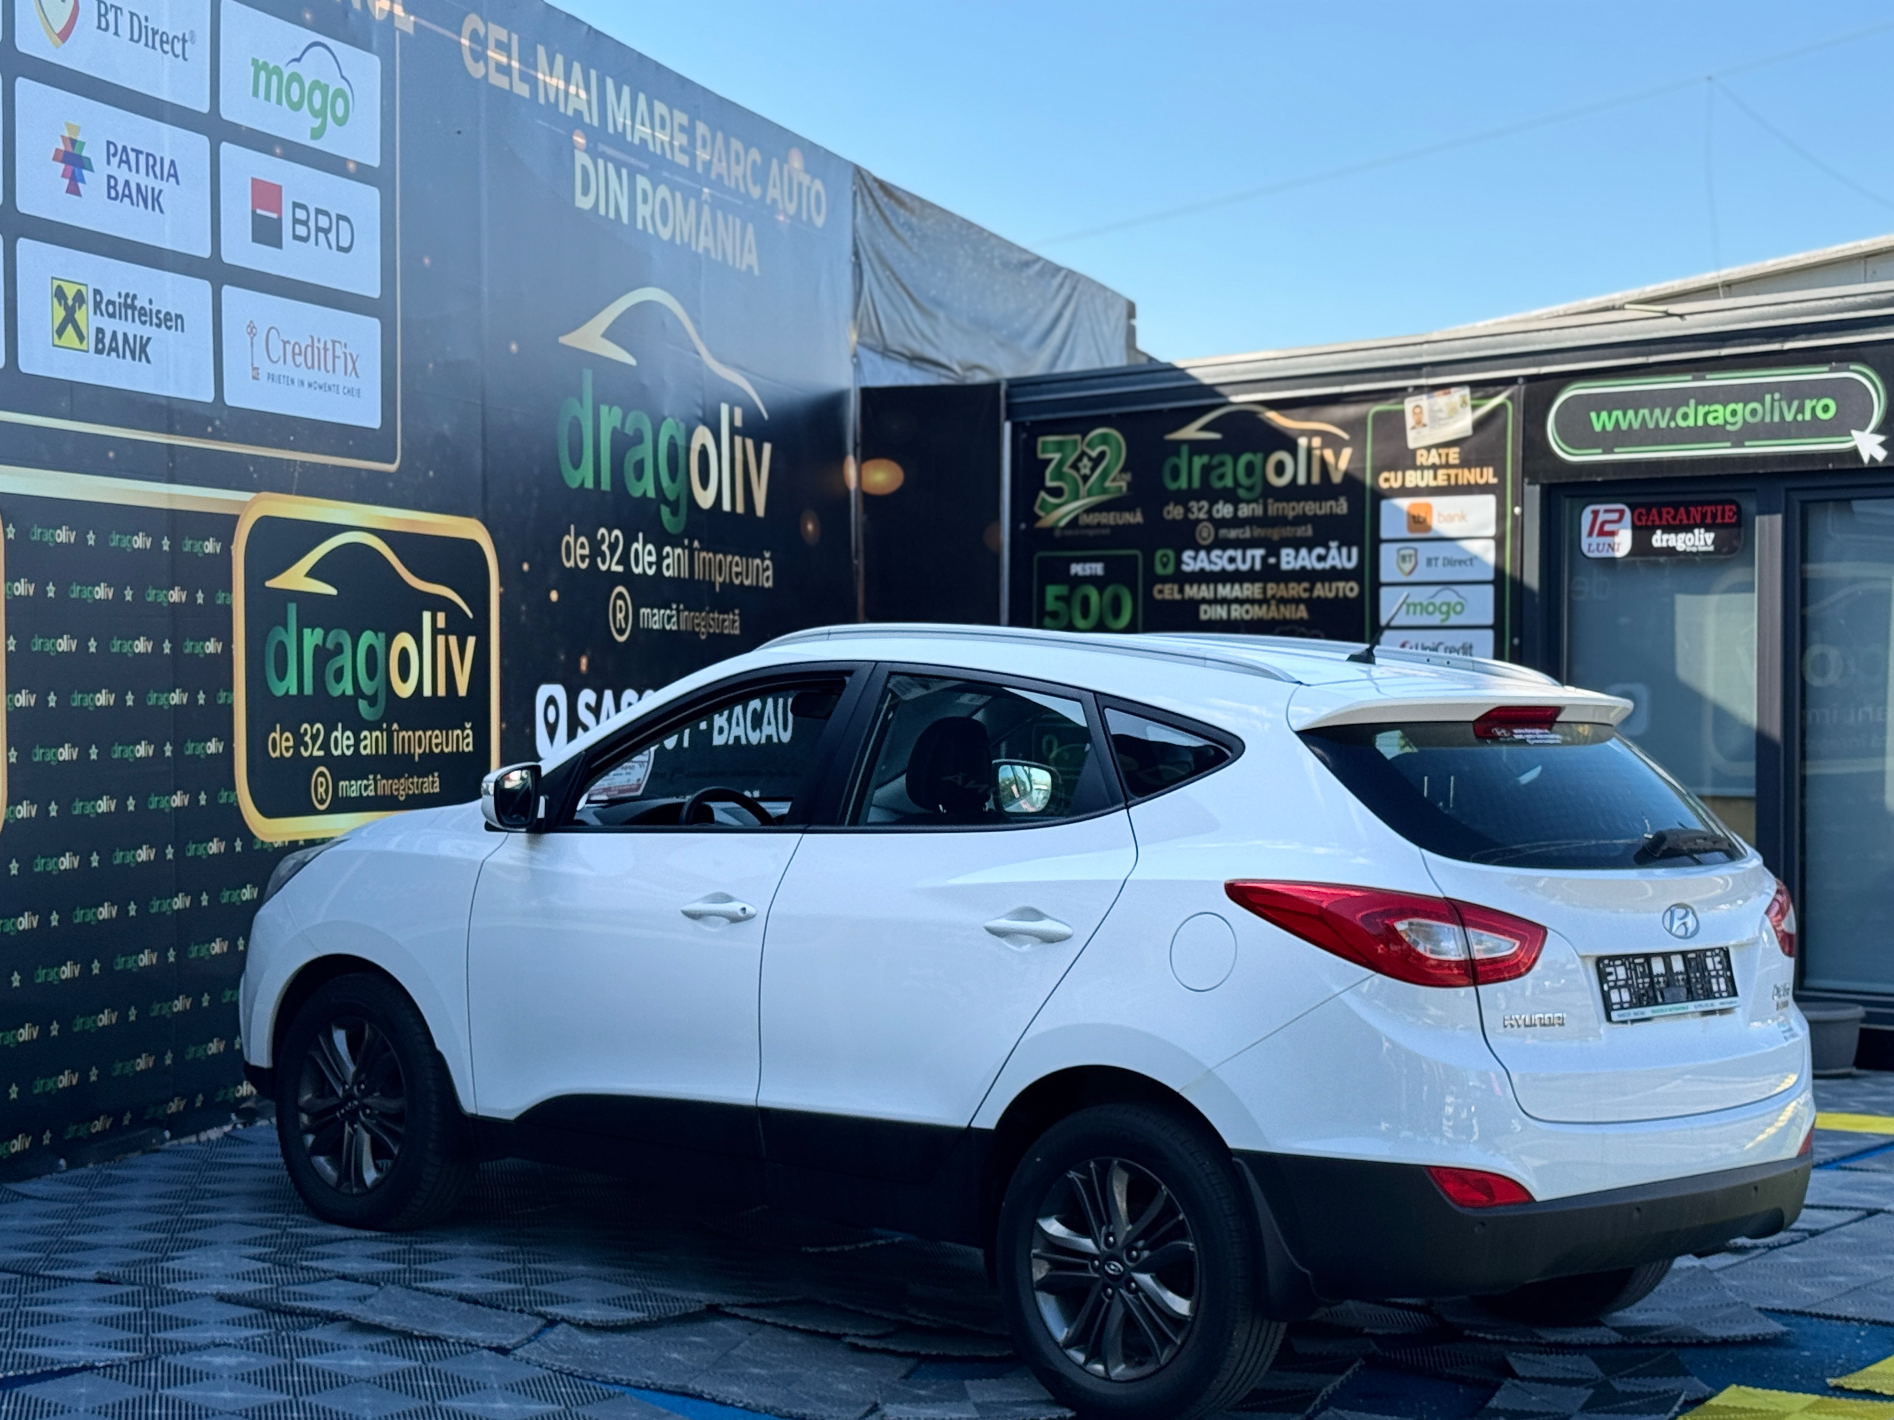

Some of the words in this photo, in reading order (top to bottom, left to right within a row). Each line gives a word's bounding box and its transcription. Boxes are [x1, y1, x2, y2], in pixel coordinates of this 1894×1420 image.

[96, 0, 123, 37] BT
[251, 57, 350, 140] mogo
[461, 13, 530, 98] CEL
[537, 44, 598, 127] MAI
[606, 76, 690, 167] MARE
[695, 120, 762, 199] PARC
[766, 154, 826, 228] AUTO
[106, 139, 180, 186] PATRIA
[107, 176, 165, 215] BANK
[292, 201, 354, 253] BRD
[574, 149, 628, 225] DIN
[636, 174, 759, 276] ROMÂNIA
[92, 288, 185, 333] Raiffeisen
[94, 326, 152, 364] BANK
[266, 326, 360, 378] CreditFix
[1589, 393, 1836, 432] www.dragoliv.ro
[557, 368, 771, 535] dragoliv
[1416, 447, 1460, 466] RATE
[1163, 437, 1352, 499] dragoliv
[1378, 472, 1402, 488] CU
[1405, 467, 1498, 488] BULETINUL
[1163, 502, 1184, 520] de
[1188, 501, 1209, 519] 32
[1212, 501, 1234, 518] de
[1238, 500, 1263, 517] ani
[1267, 496, 1348, 520] împreună
[1438, 511, 1467, 523] bank
[1586, 508, 1625, 538] 12
[1633, 505, 1737, 526] GARANTIE
[30, 525, 76, 546] dragoliv
[109, 532, 152, 552] dragoliv
[182, 537, 222, 556] dragoliv
[1588, 542, 1621, 554] LUNI
[1652, 528, 1715, 552] dragoliv
[562, 525, 590, 569] de
[597, 528, 624, 573] 32
[630, 532, 656, 576] de
[662, 540, 689, 580] ani
[694, 541, 774, 592] împreună
[1070, 562, 1104, 576] PESTE
[1181, 549, 1265, 572] SASCUT
[1280, 541, 1358, 570] BACĂU
[1426, 557, 1440, 568] BT
[5, 578, 35, 598] goliv
[69, 582, 114, 603] dragoliv
[146, 586, 187, 606] dragoliv
[1153, 584, 1181, 599] CEL
[1184, 584, 1214, 599] MAI
[1217, 583, 1263, 599] MARE
[1266, 582, 1310, 598] PARC
[1312, 581, 1359, 598] AUTO
[640, 603, 677, 632] marcă
[1042, 584, 1132, 630] 500
[1199, 604, 1228, 620] DIN
[1230, 600, 1308, 620] ROMÂNIA
[1404, 601, 1465, 622] mogo
[31, 635, 77, 656] dragoliv
[110, 636, 153, 657] dragoliv
[183, 638, 222, 657] dragoliv
[264, 602, 476, 720] dragoliv
[7, 689, 36, 710] goliv
[70, 689, 115, 710] dragoliv
[146, 688, 188, 709] dragoliv
[32, 743, 78, 765] dragoliv
[110, 740, 154, 762] dragoliv
[184, 738, 224, 758] dragoliv
[268, 724, 294, 758] de
[300, 723, 324, 756] 32
[330, 722, 354, 755] de
[360, 724, 386, 755] ani
[392, 722, 474, 762] împreună
[338, 774, 375, 797] marcă
[72, 796, 116, 817] dragoliv
[148, 790, 190, 812] dragoliv
[34, 852, 79, 874] dragoliv
[112, 844, 156, 866] dragoliv
[185, 838, 226, 858] dragoliv
[0, 911, 39, 936] ragoliv
[72, 902, 118, 925] dragoliv
[150, 892, 191, 914] dragoliv
[220, 884, 258, 905] dragoliv
[34, 960, 81, 984] dragoliv
[113, 949, 158, 971] dragoliv
[188, 938, 228, 960] dragoliv
[0, 1022, 40, 1048] ragoliv
[72, 1008, 118, 1032] dragoliv
[150, 994, 192, 1018] dragoliv
[1503, 1012, 1566, 1028] HYUNDAI
